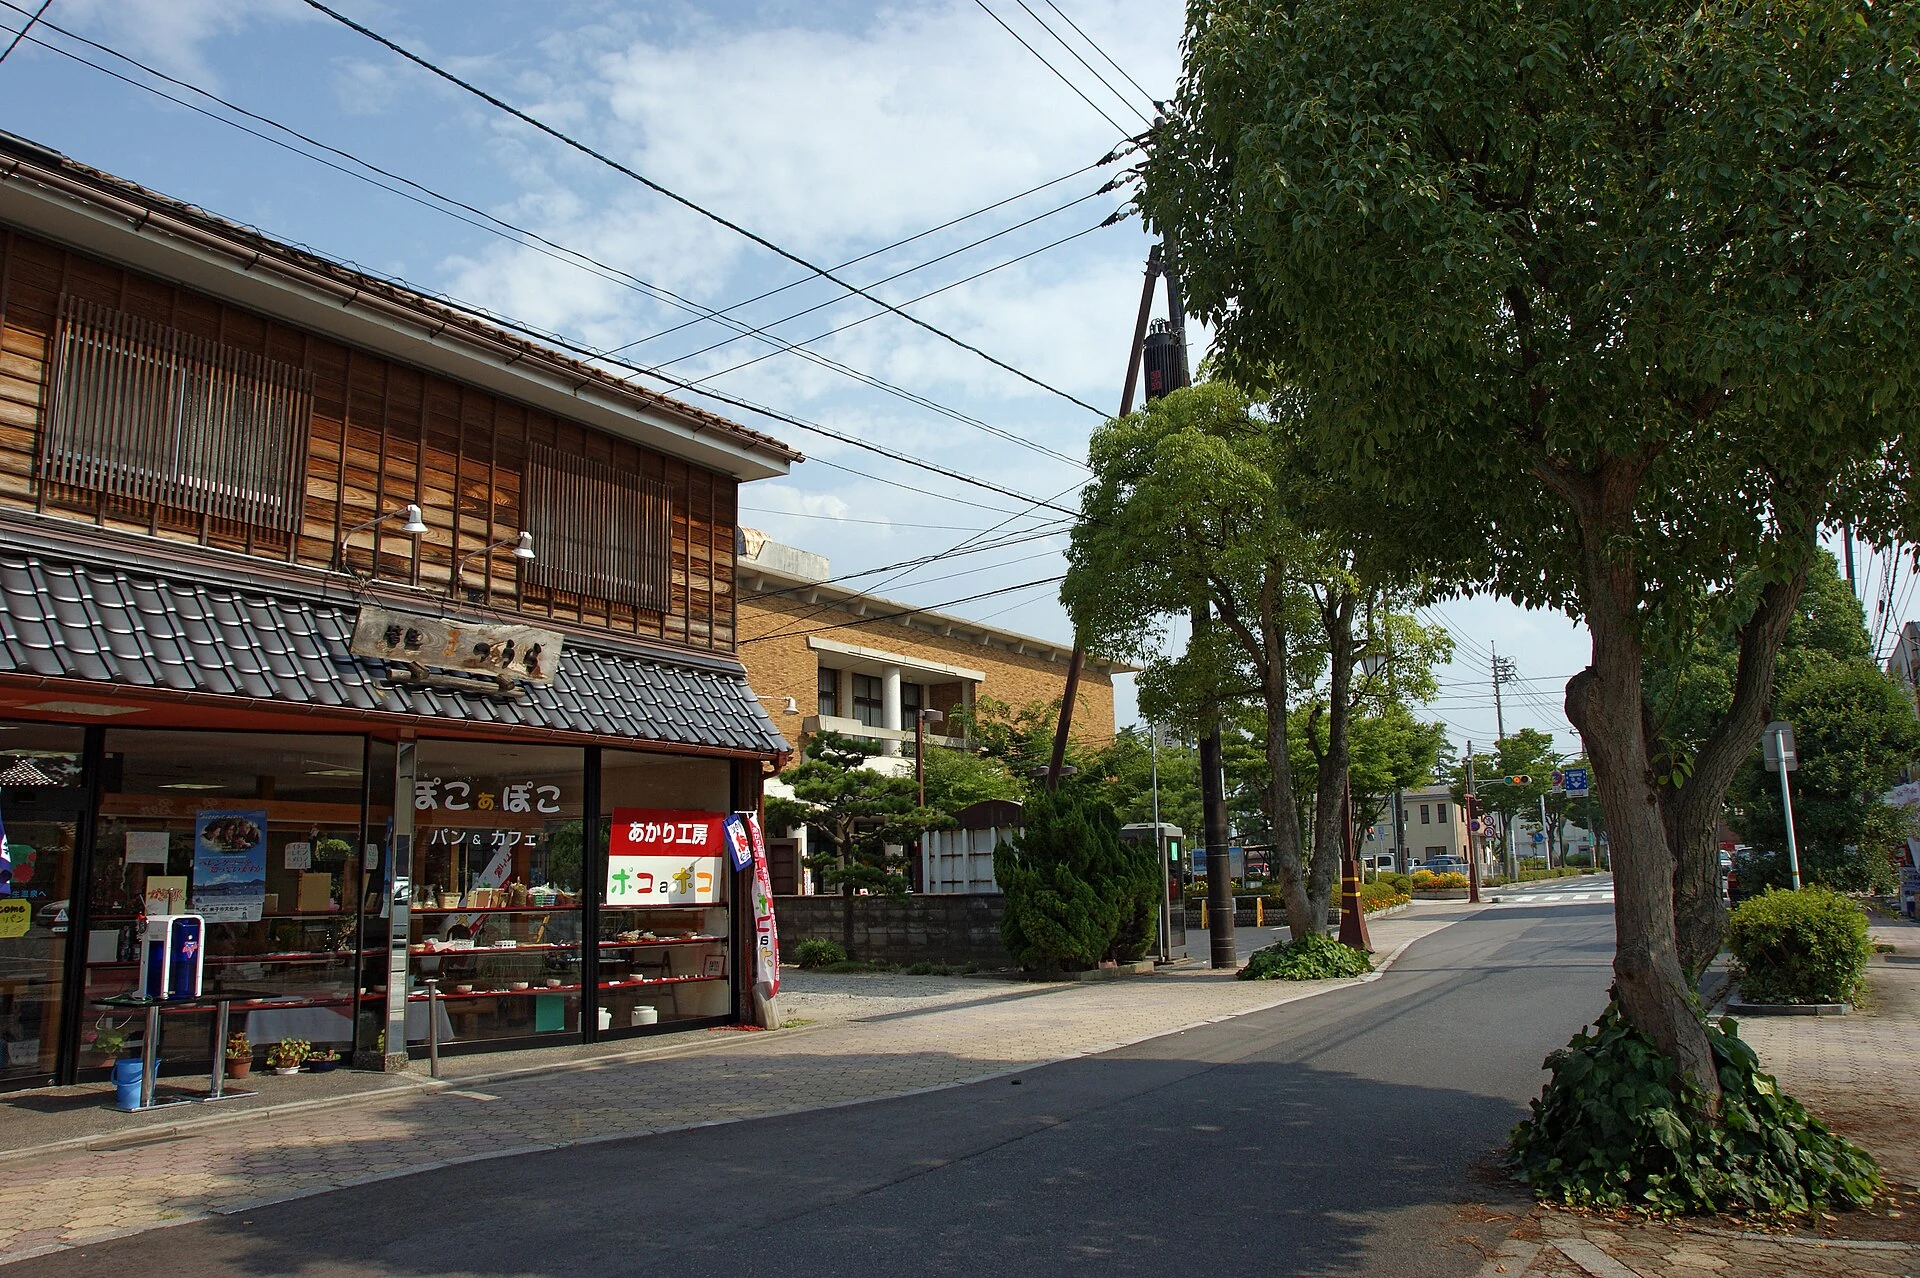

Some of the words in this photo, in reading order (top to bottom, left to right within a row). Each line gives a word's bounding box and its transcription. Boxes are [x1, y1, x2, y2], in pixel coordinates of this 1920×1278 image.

[431, 828, 466, 846] パン
[472, 834, 481, 845] &
[491, 830, 537, 846] カフェ
[628, 821, 709, 845] あかり工房
